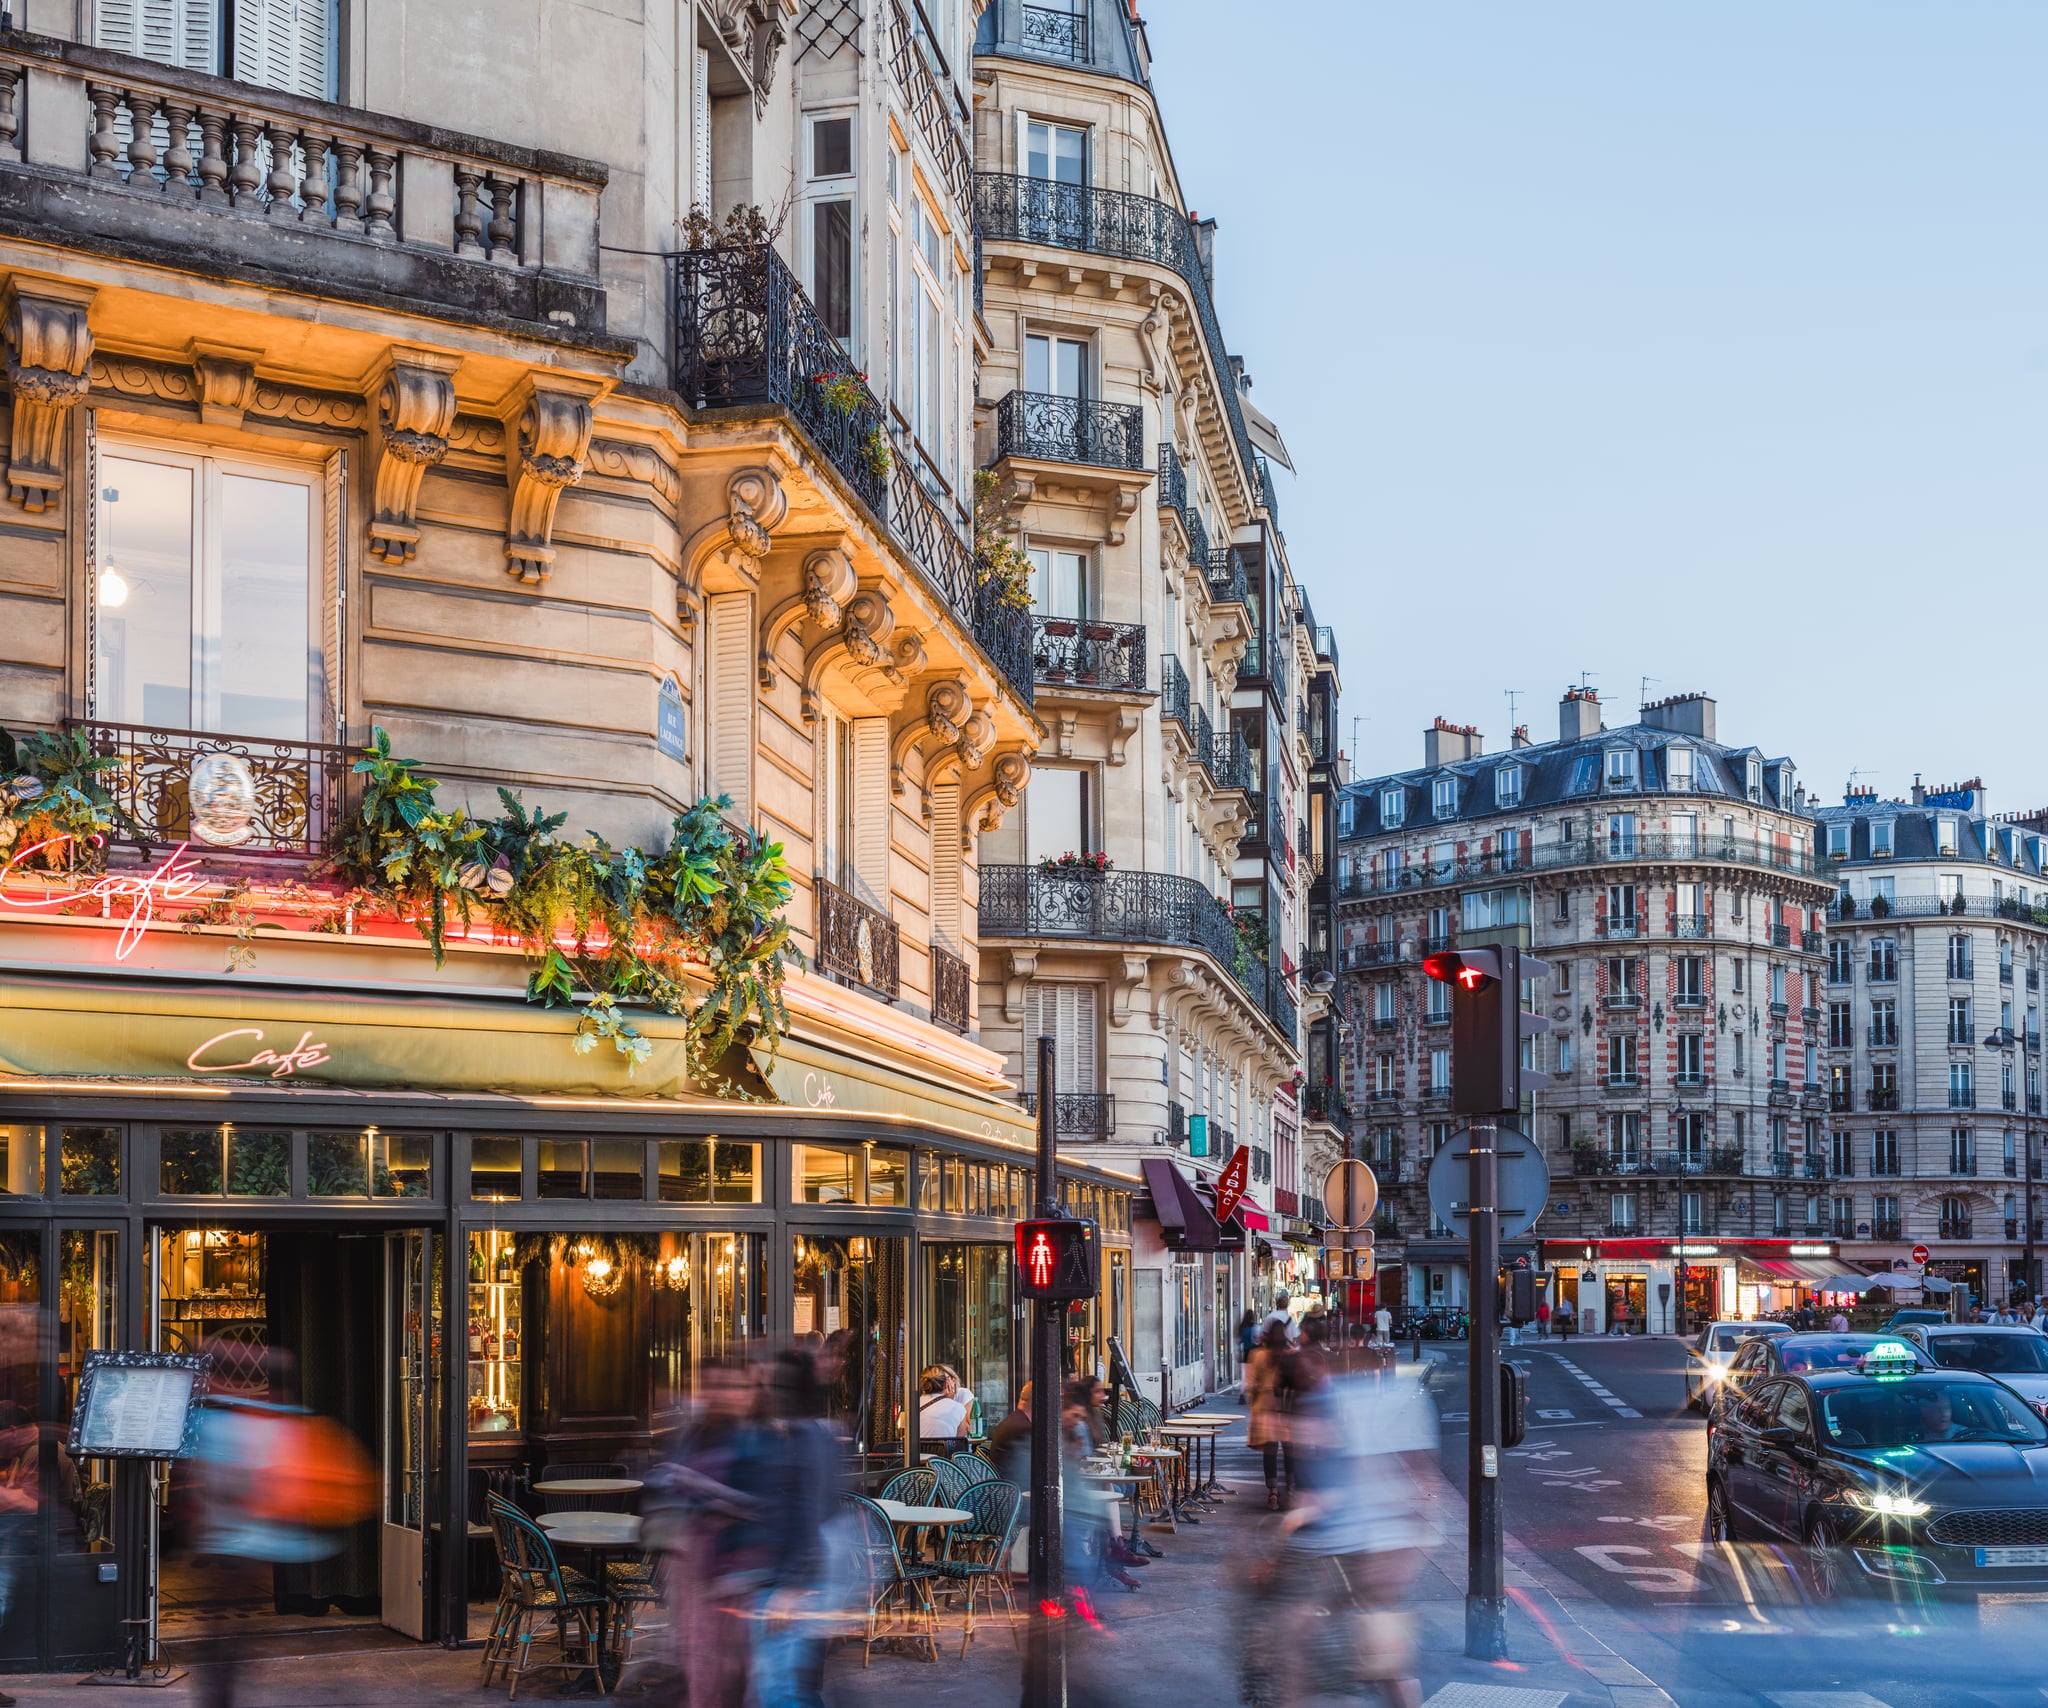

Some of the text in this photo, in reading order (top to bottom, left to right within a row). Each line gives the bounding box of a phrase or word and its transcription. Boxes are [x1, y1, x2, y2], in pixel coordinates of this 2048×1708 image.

[660, 726, 683, 749] LAGRANGE
[0, 834, 210, 960] Café
[187, 1028, 332, 1078] Café
[1222, 1162, 1243, 1206] TABAC
